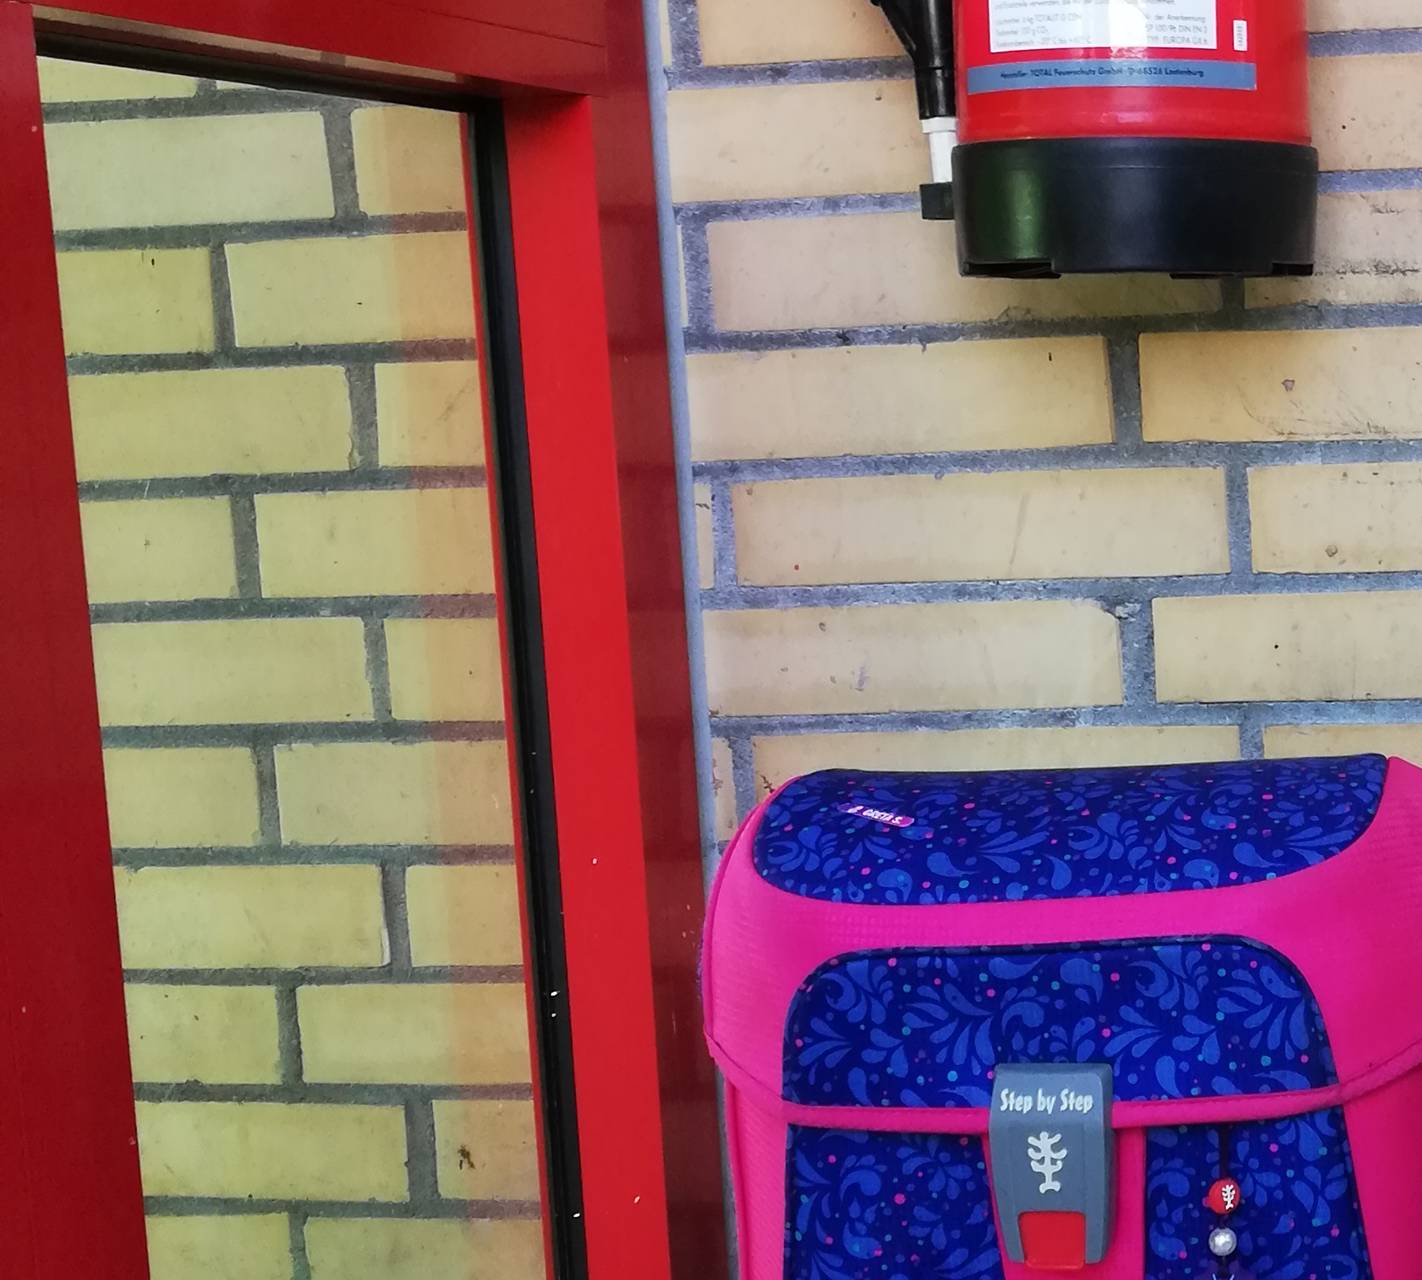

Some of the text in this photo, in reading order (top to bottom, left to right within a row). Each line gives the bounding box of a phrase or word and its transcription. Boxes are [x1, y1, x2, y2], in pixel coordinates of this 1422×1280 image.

[1000, 1088, 1094, 1114] Step by Step
